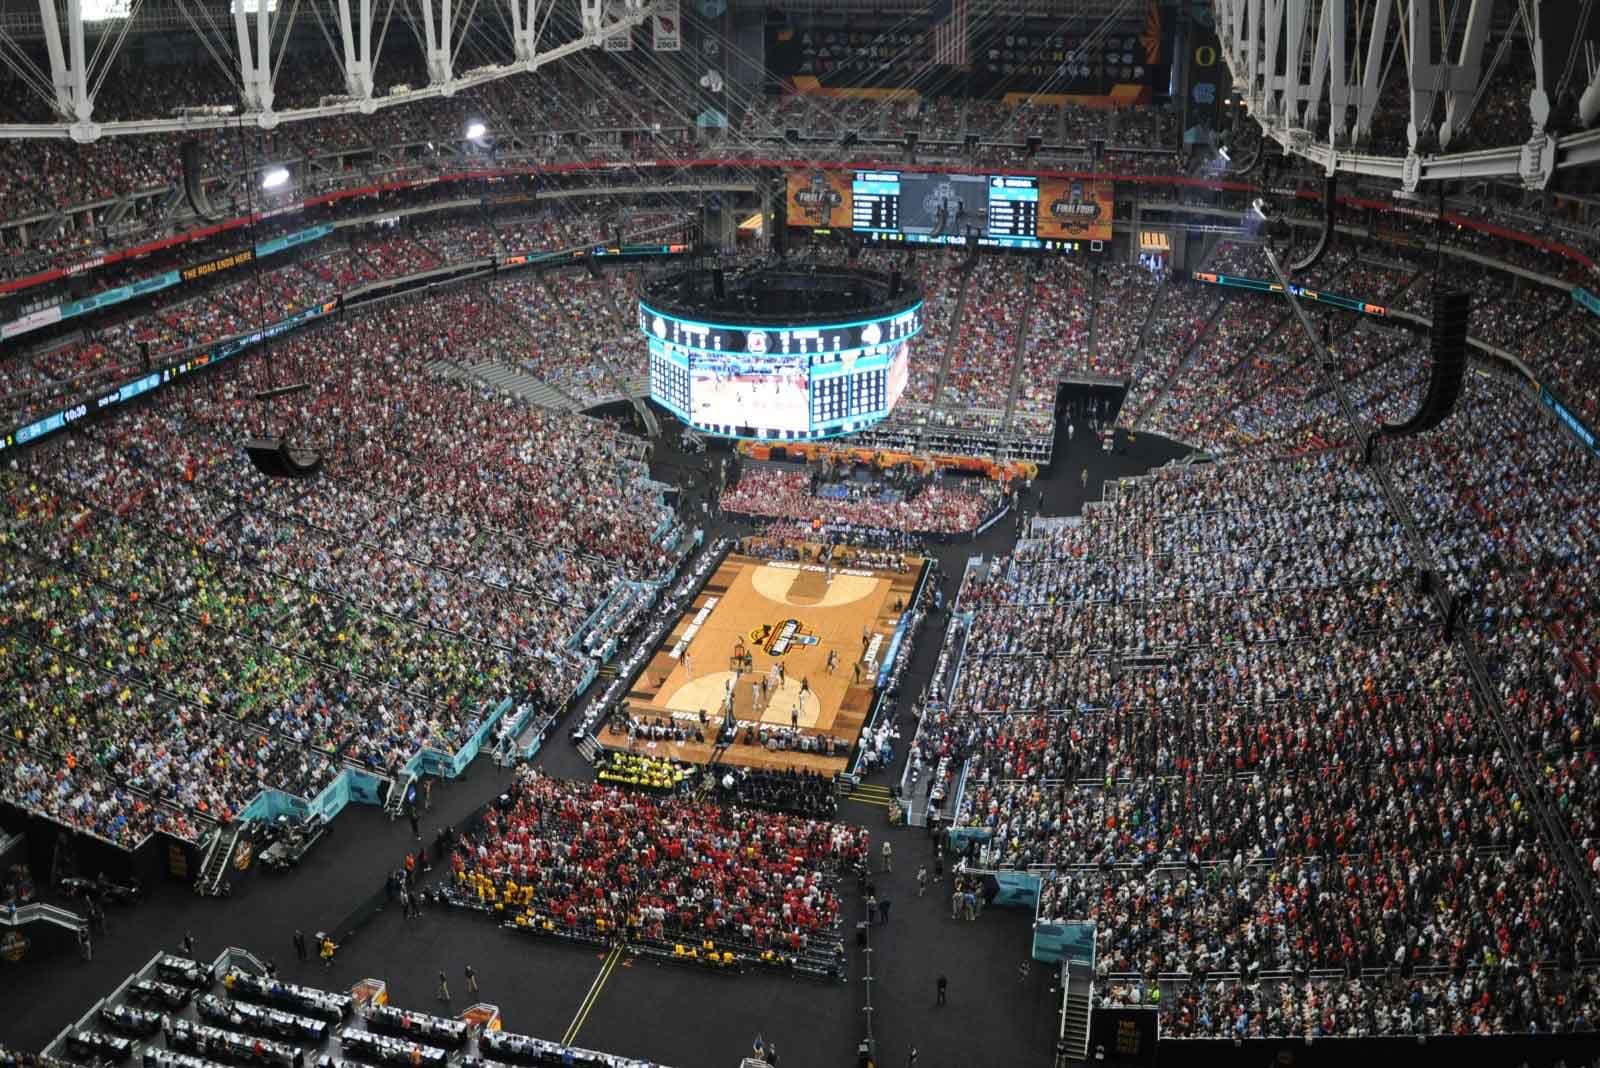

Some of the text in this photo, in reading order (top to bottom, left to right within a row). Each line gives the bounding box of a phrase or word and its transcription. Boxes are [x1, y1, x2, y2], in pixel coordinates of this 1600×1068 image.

[183, 251, 252, 281] THE ROAD ENDS HERE
[65, 405, 87, 421] 10:30
